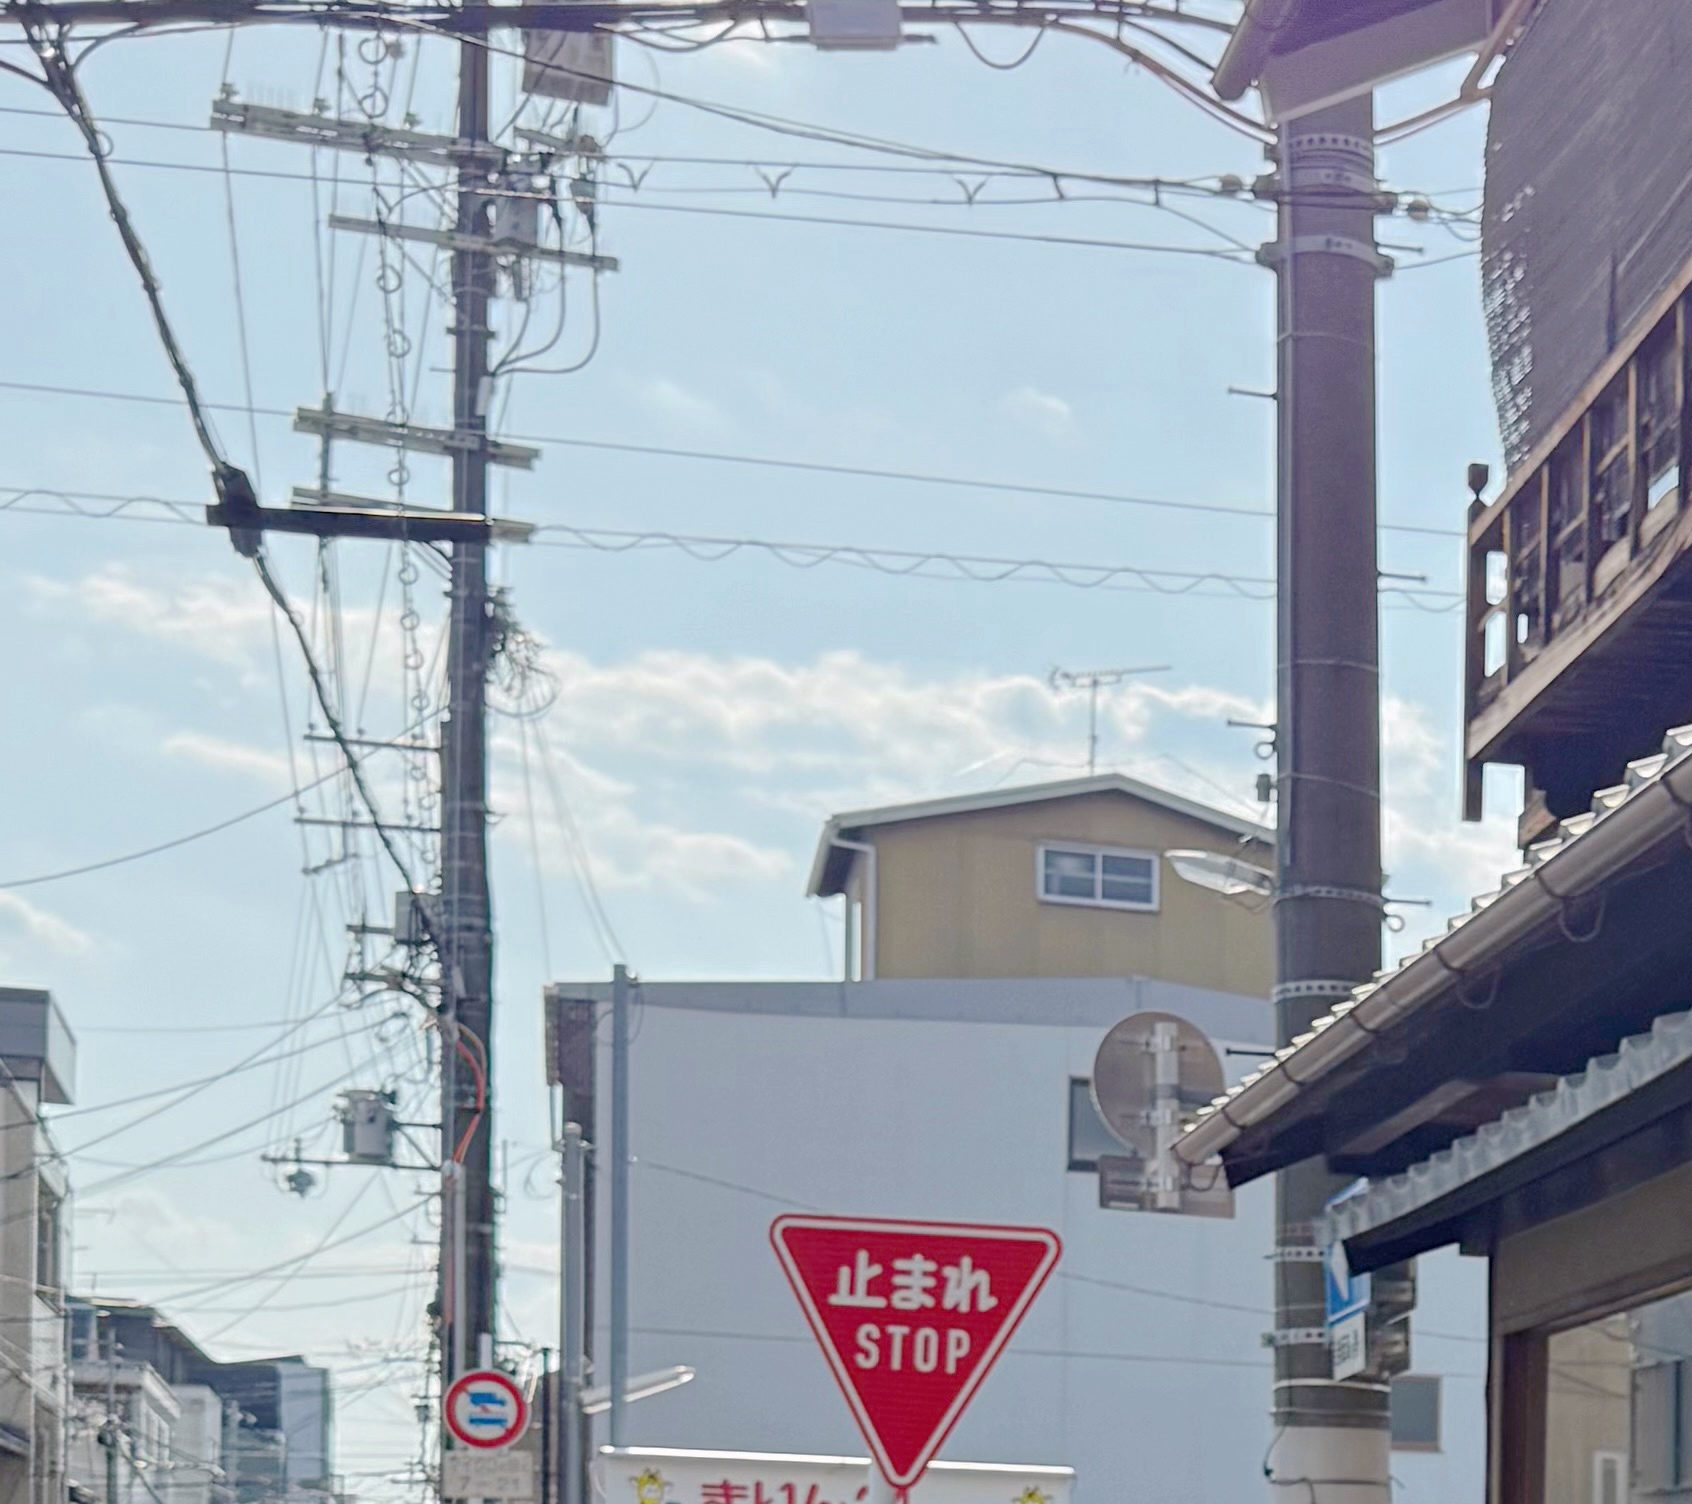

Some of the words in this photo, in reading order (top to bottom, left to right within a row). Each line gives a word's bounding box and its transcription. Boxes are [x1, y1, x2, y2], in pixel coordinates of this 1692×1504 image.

[828, 1249, 998, 1313] 止まれ
[854, 1323, 971, 1374] STOP
